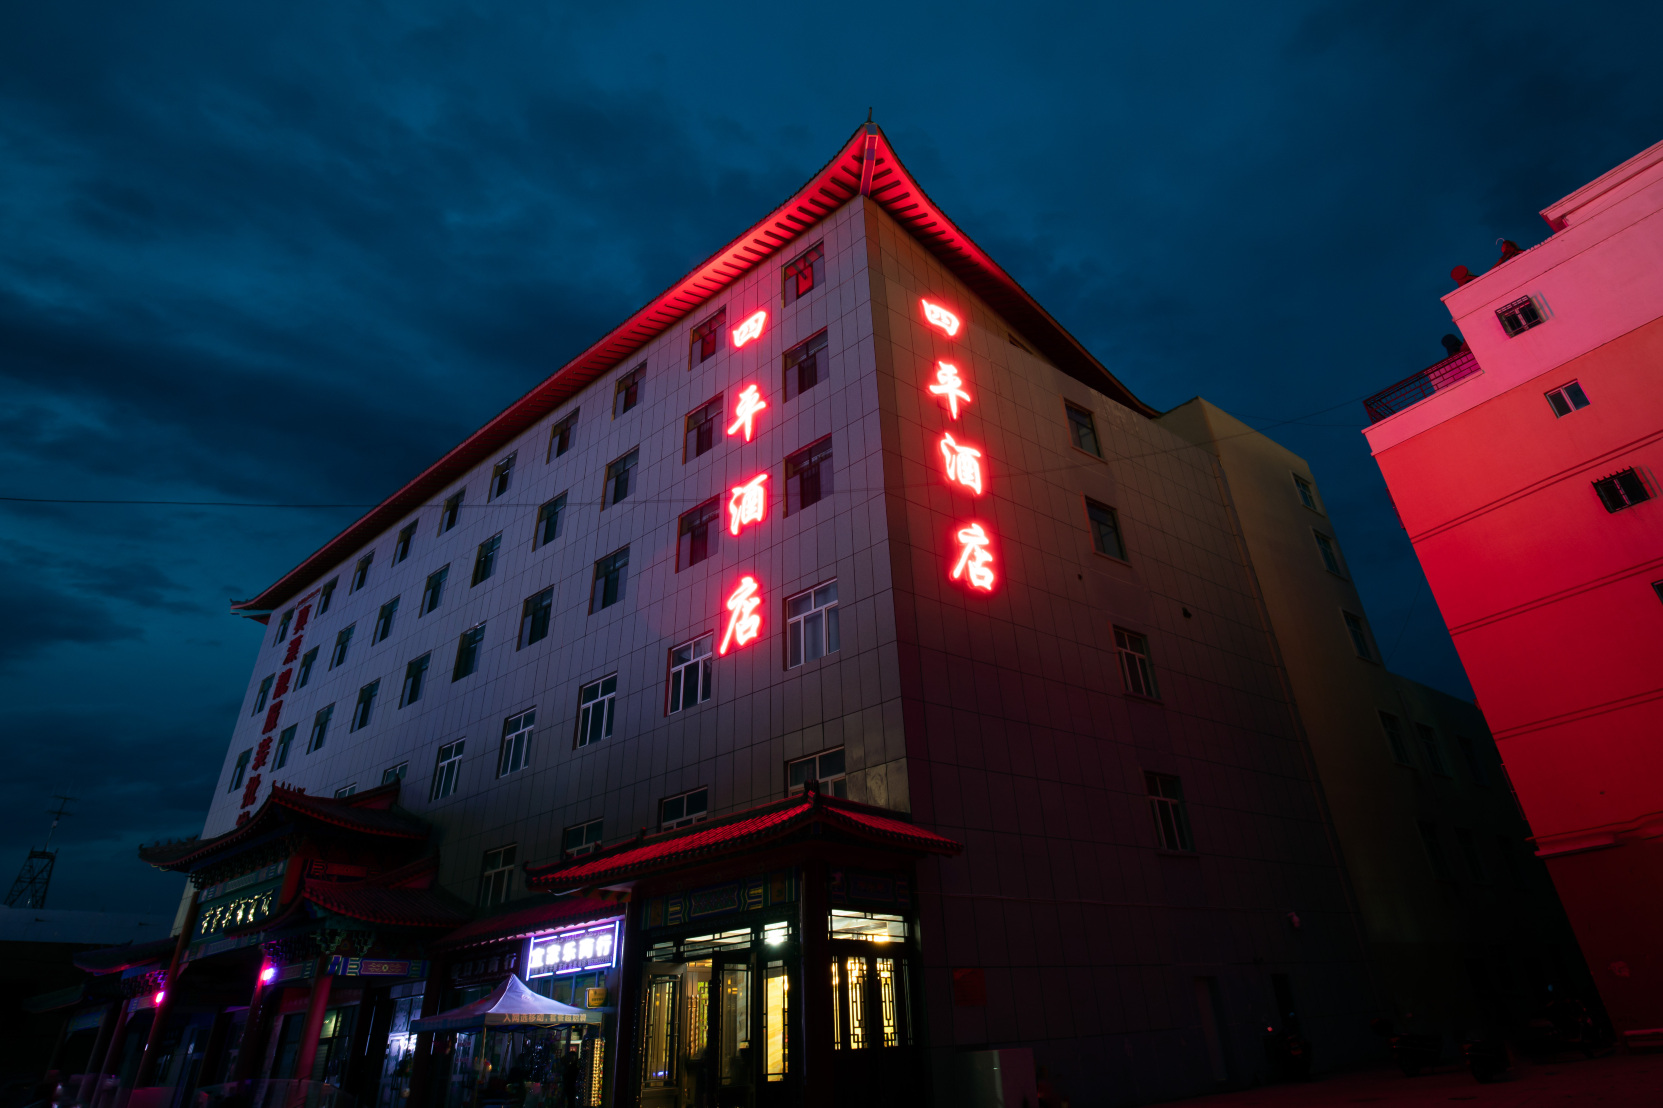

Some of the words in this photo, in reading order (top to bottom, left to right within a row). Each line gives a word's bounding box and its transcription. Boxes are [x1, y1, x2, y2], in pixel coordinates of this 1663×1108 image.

[720, 310, 767, 656] 四平酒店
[920, 299, 996, 592] 四平酒店
